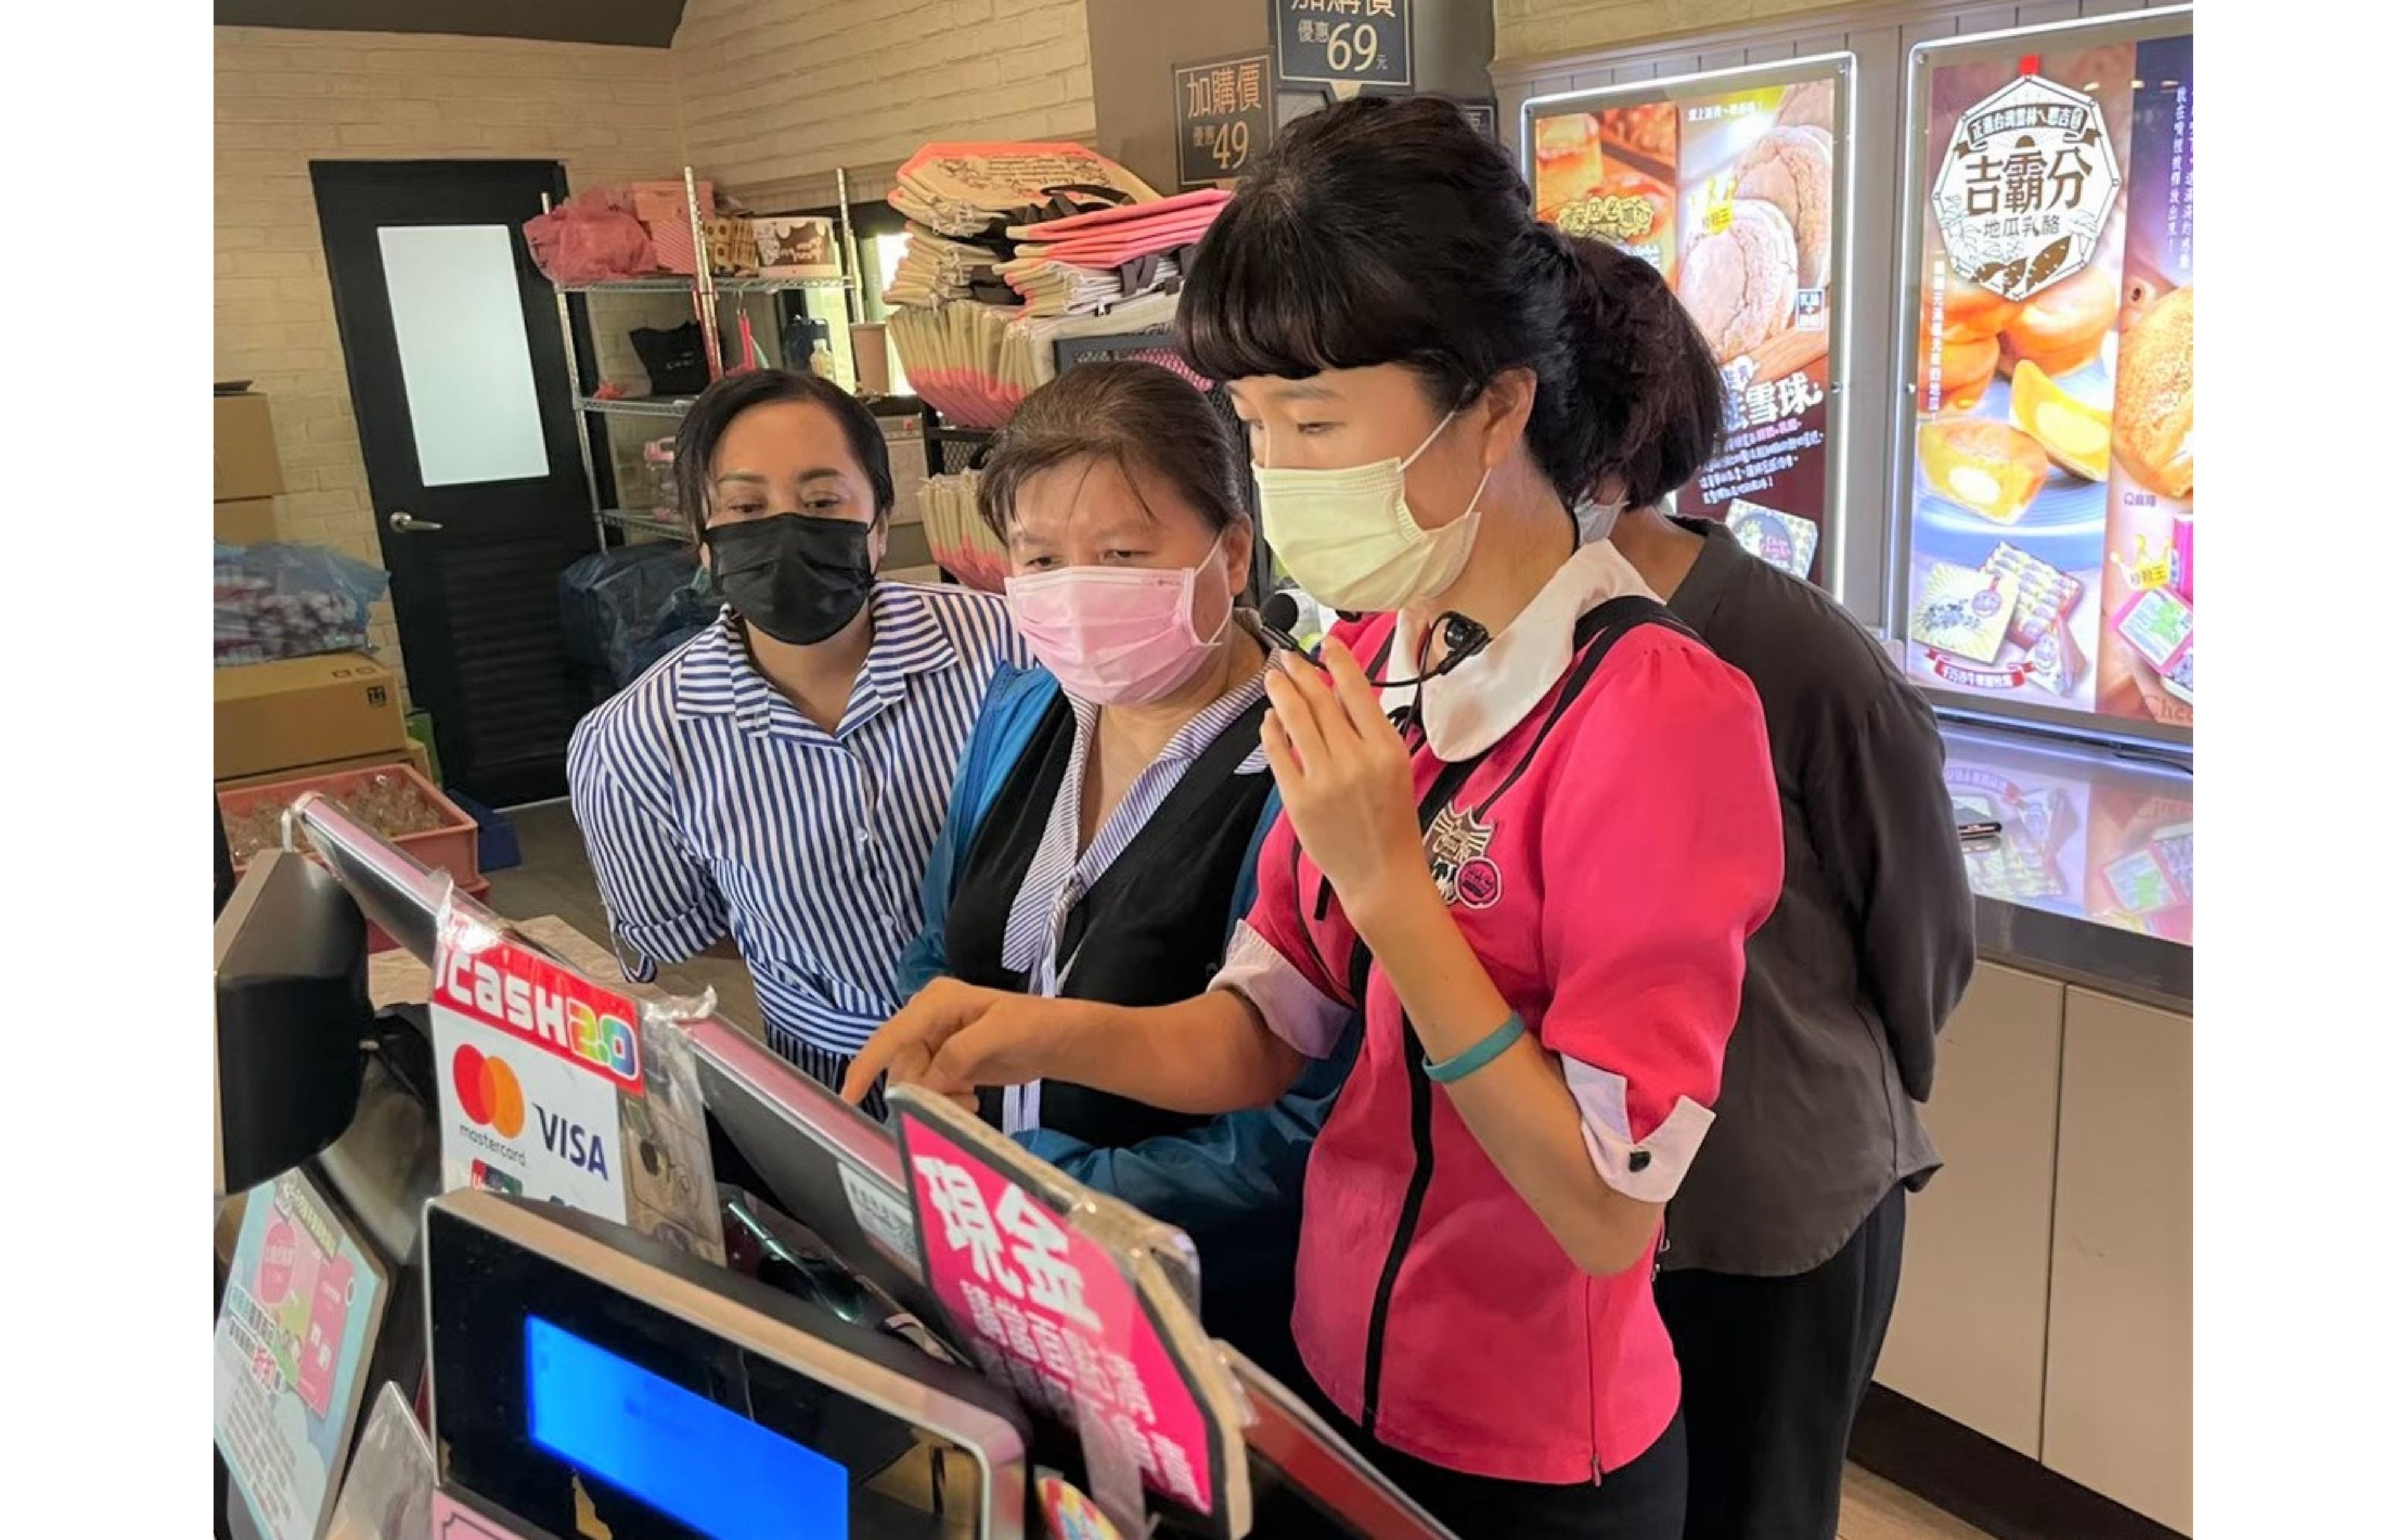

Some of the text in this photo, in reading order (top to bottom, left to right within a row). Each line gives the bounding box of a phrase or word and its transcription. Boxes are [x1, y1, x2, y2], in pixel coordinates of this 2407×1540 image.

[1298, 20, 1329, 45] 優惠
[1327, 23, 1378, 72] 69
[1187, 64, 1262, 119] 加購價
[1213, 121, 1250, 170] 49
[1965, 146, 2093, 217] 吉霸分
[1982, 215, 2061, 240] 地瓜乳酪
[460, 1124, 526, 1166] mastercard
[533, 1102, 609, 1181] VISA
[910, 1154, 1104, 1332] 現金
[960, 1278, 1157, 1425] 請當面點清
